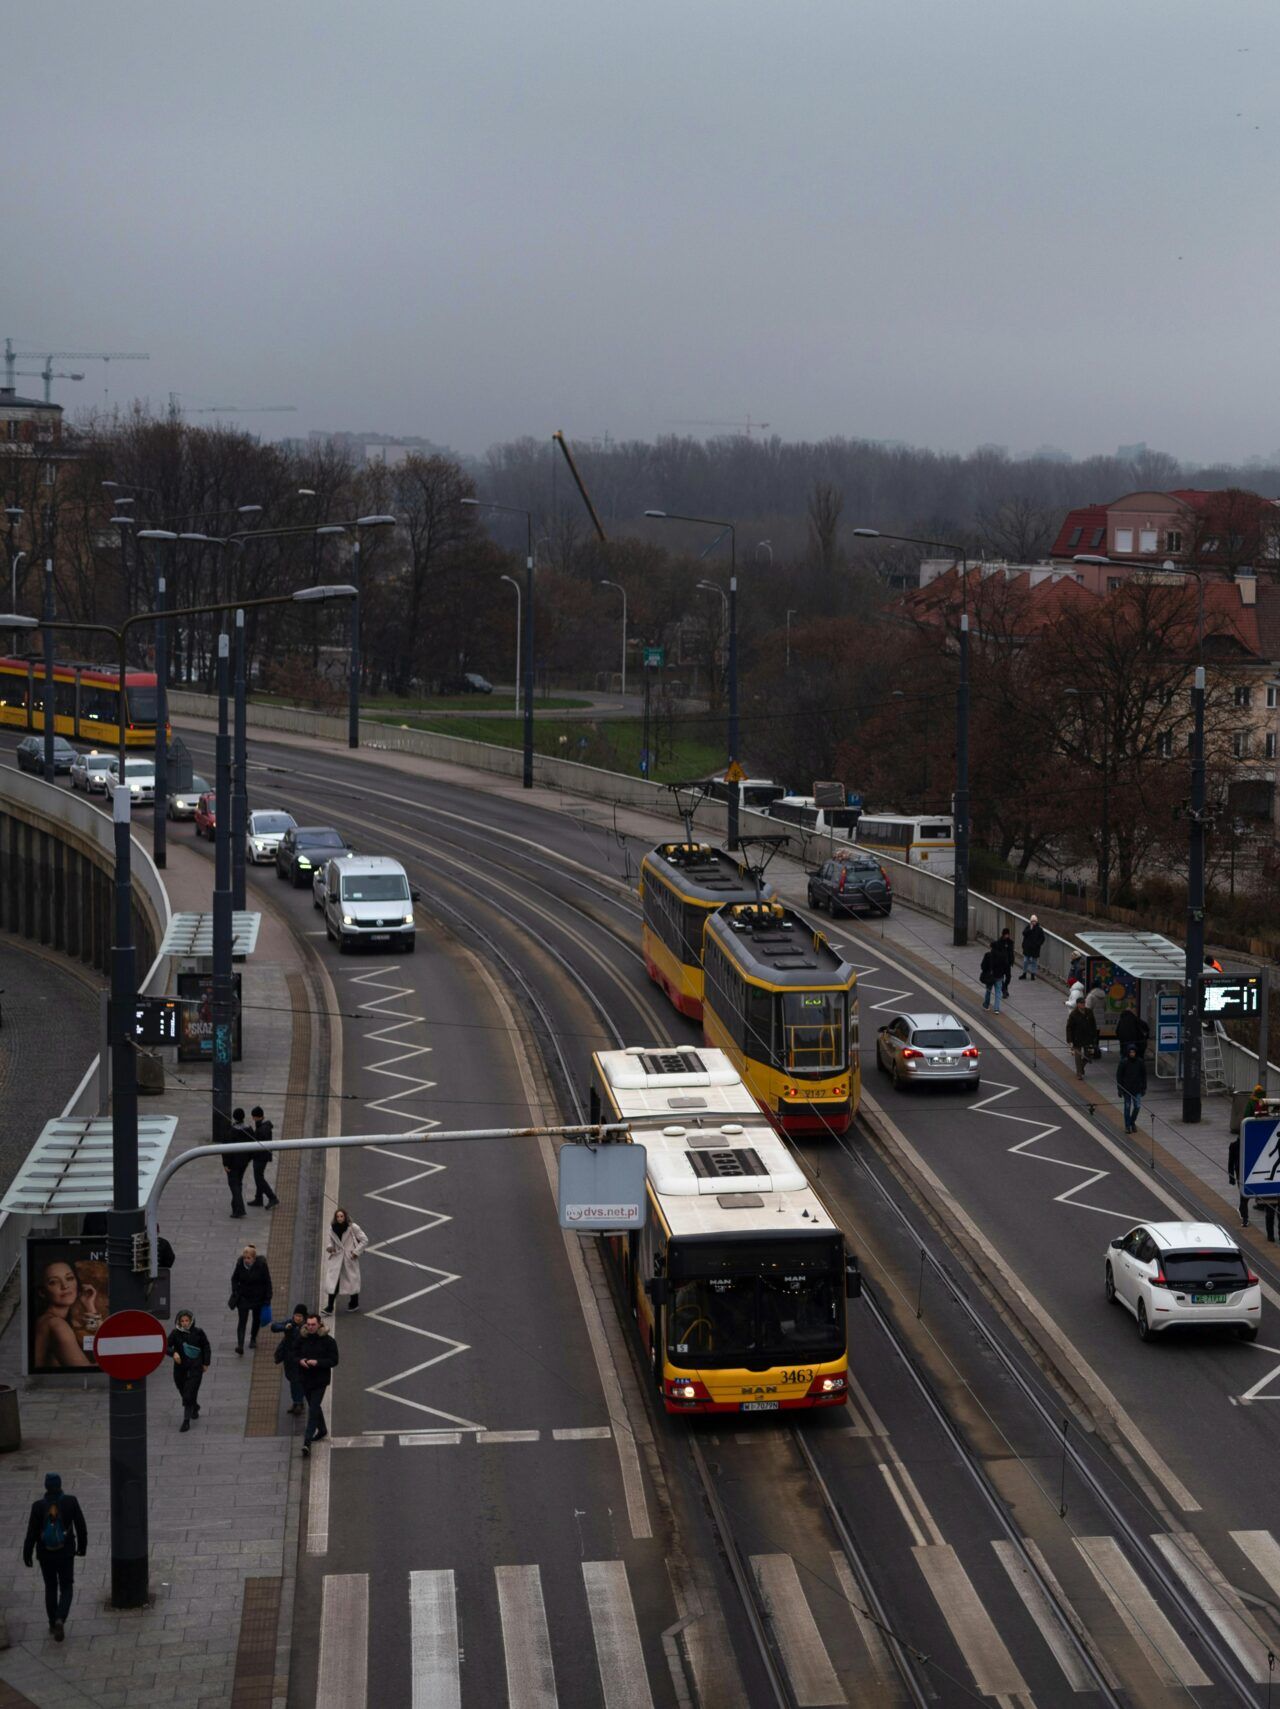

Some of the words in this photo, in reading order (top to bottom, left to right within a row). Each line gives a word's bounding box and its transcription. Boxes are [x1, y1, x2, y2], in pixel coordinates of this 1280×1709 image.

[805, 1089, 826, 1097] 2147
[584, 1206, 638, 1219] dvs.net.pl
[780, 1370, 814, 1384] 3463
[741, 1386, 777, 1395] MAN
